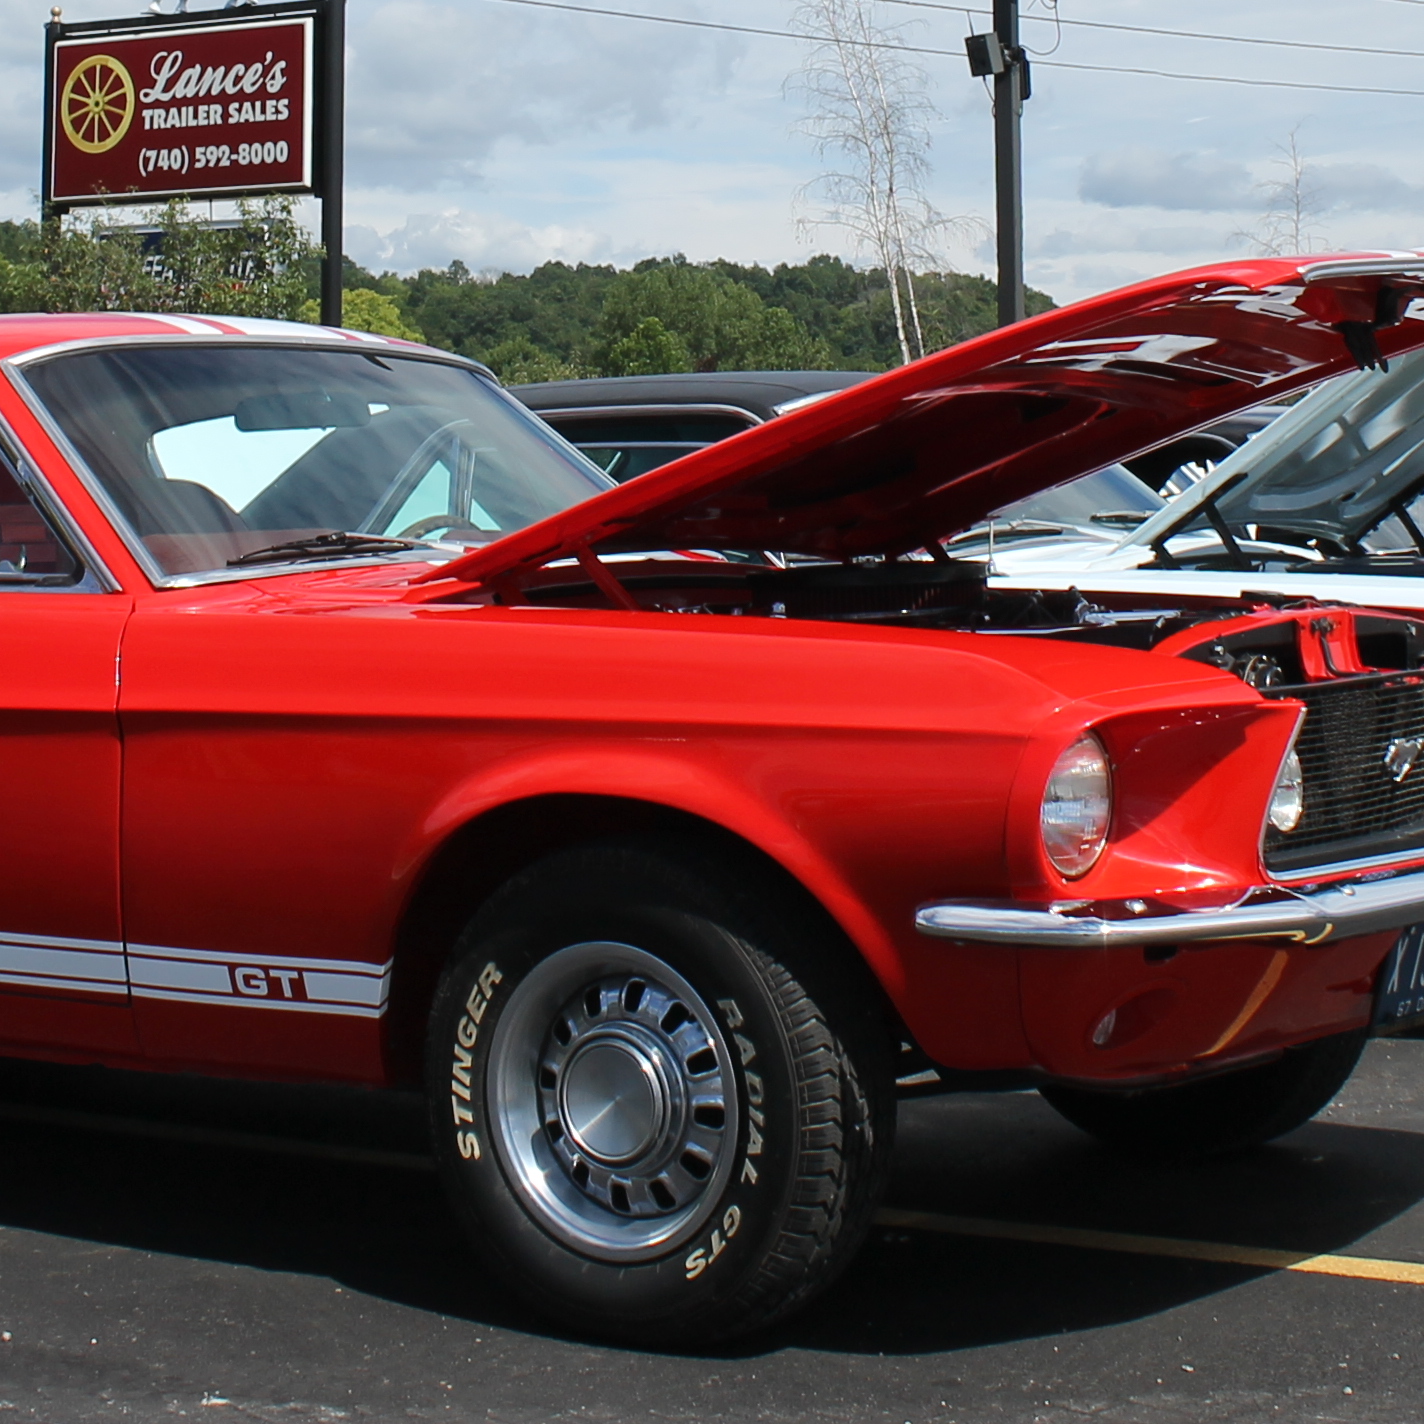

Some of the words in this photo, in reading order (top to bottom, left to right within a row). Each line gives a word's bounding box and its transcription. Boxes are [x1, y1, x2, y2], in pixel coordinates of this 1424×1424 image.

[139, 50, 287, 103] Lance's
[142, 104, 223, 130] TRAILER
[228, 99, 290, 125] SALES
[138, 145, 189, 177] (740)
[194, 140, 289, 169] 592-8000
[234, 966, 299, 999] GT
[451, 962, 502, 1161] STINGER
[717, 998, 766, 1185] RADIAL
[685, 1204, 741, 1279] GTS
